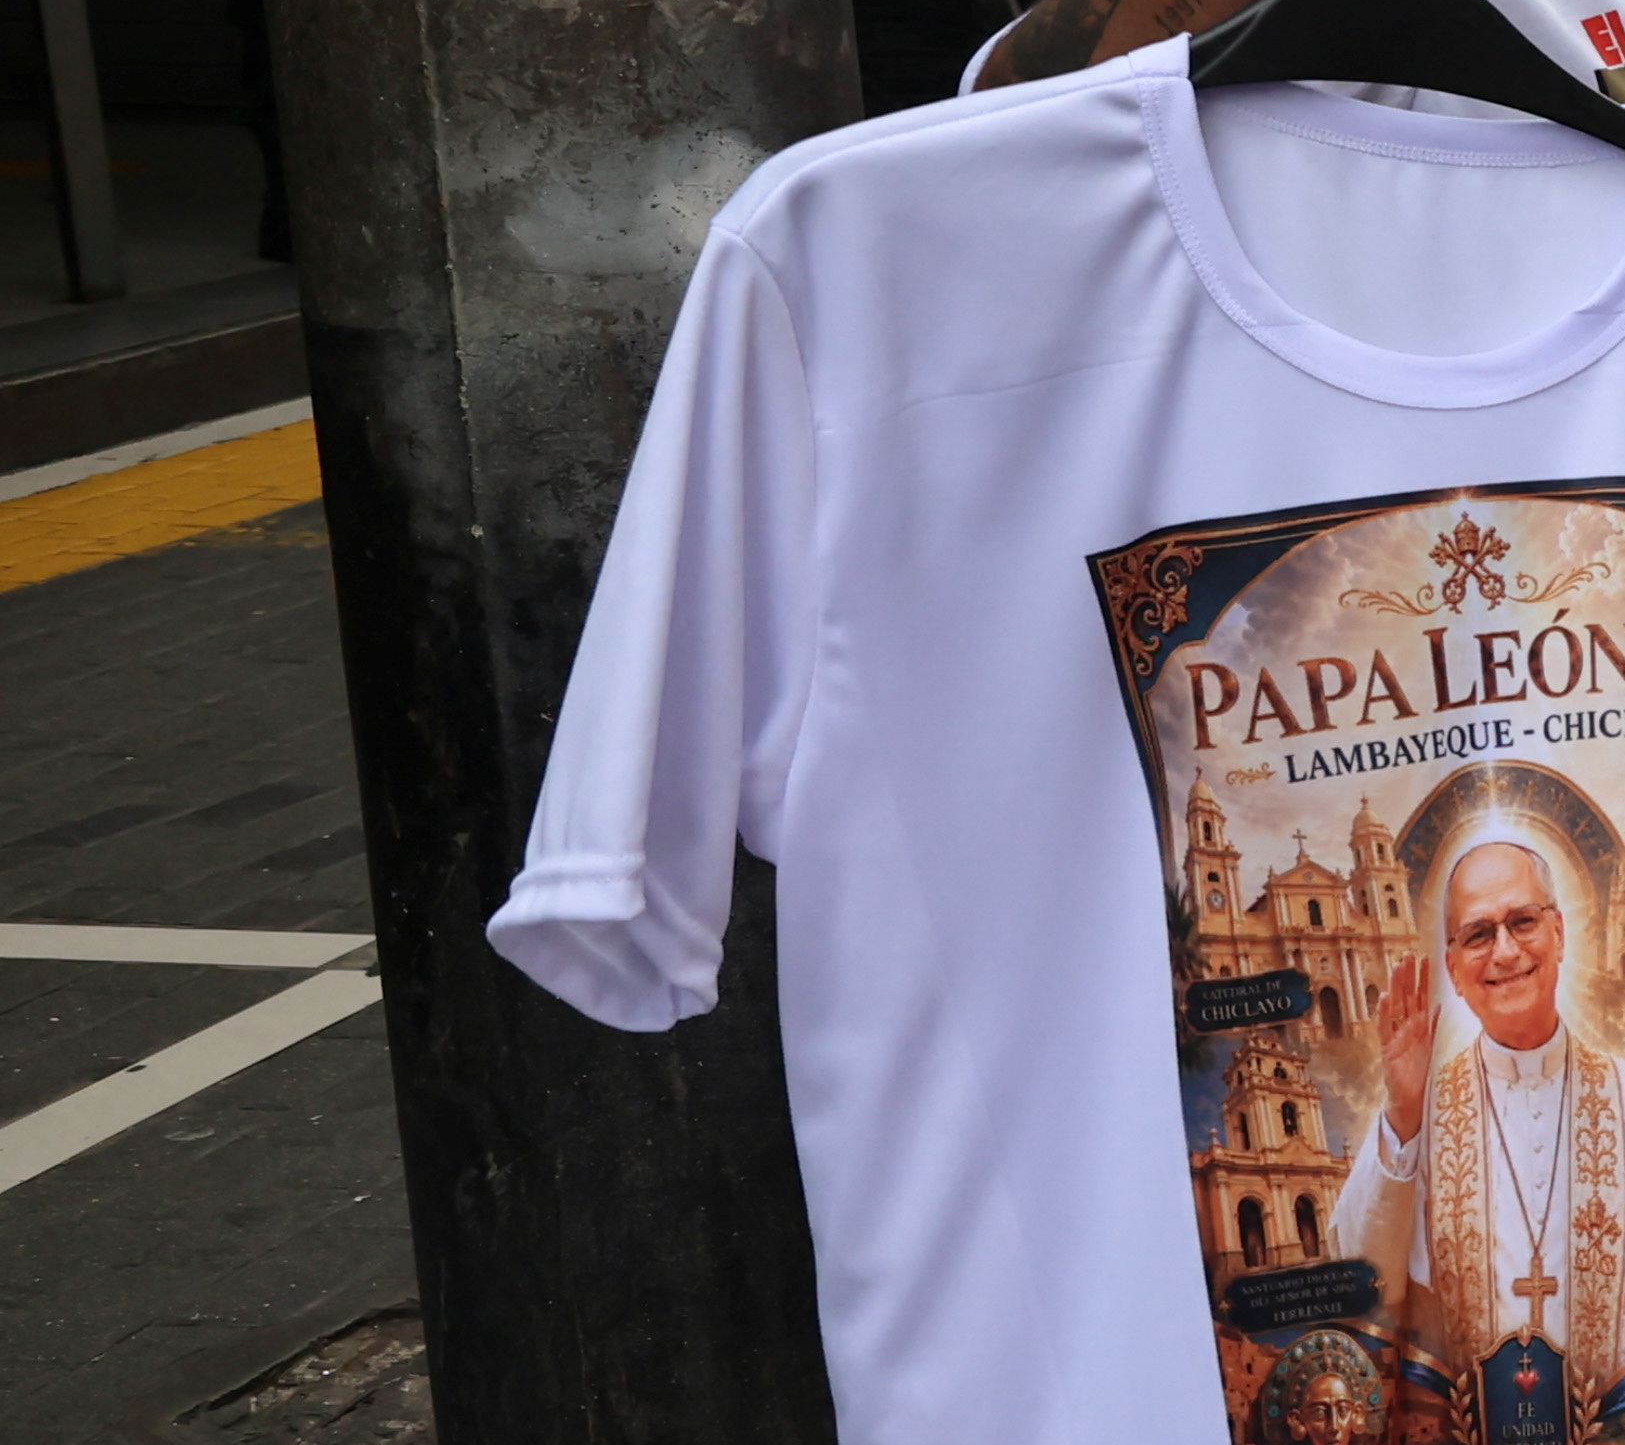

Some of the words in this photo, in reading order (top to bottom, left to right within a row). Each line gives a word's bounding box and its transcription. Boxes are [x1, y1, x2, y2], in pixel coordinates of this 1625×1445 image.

[1185, 647, 1420, 752] PAPA
[1285, 718, 1514, 784] LAMBAYEQUE
[1201, 995, 1292, 1022] CHICLAYO
[1517, 1402, 1536, 1419] FE
[1502, 1421, 1555, 1439] UNIDAD
